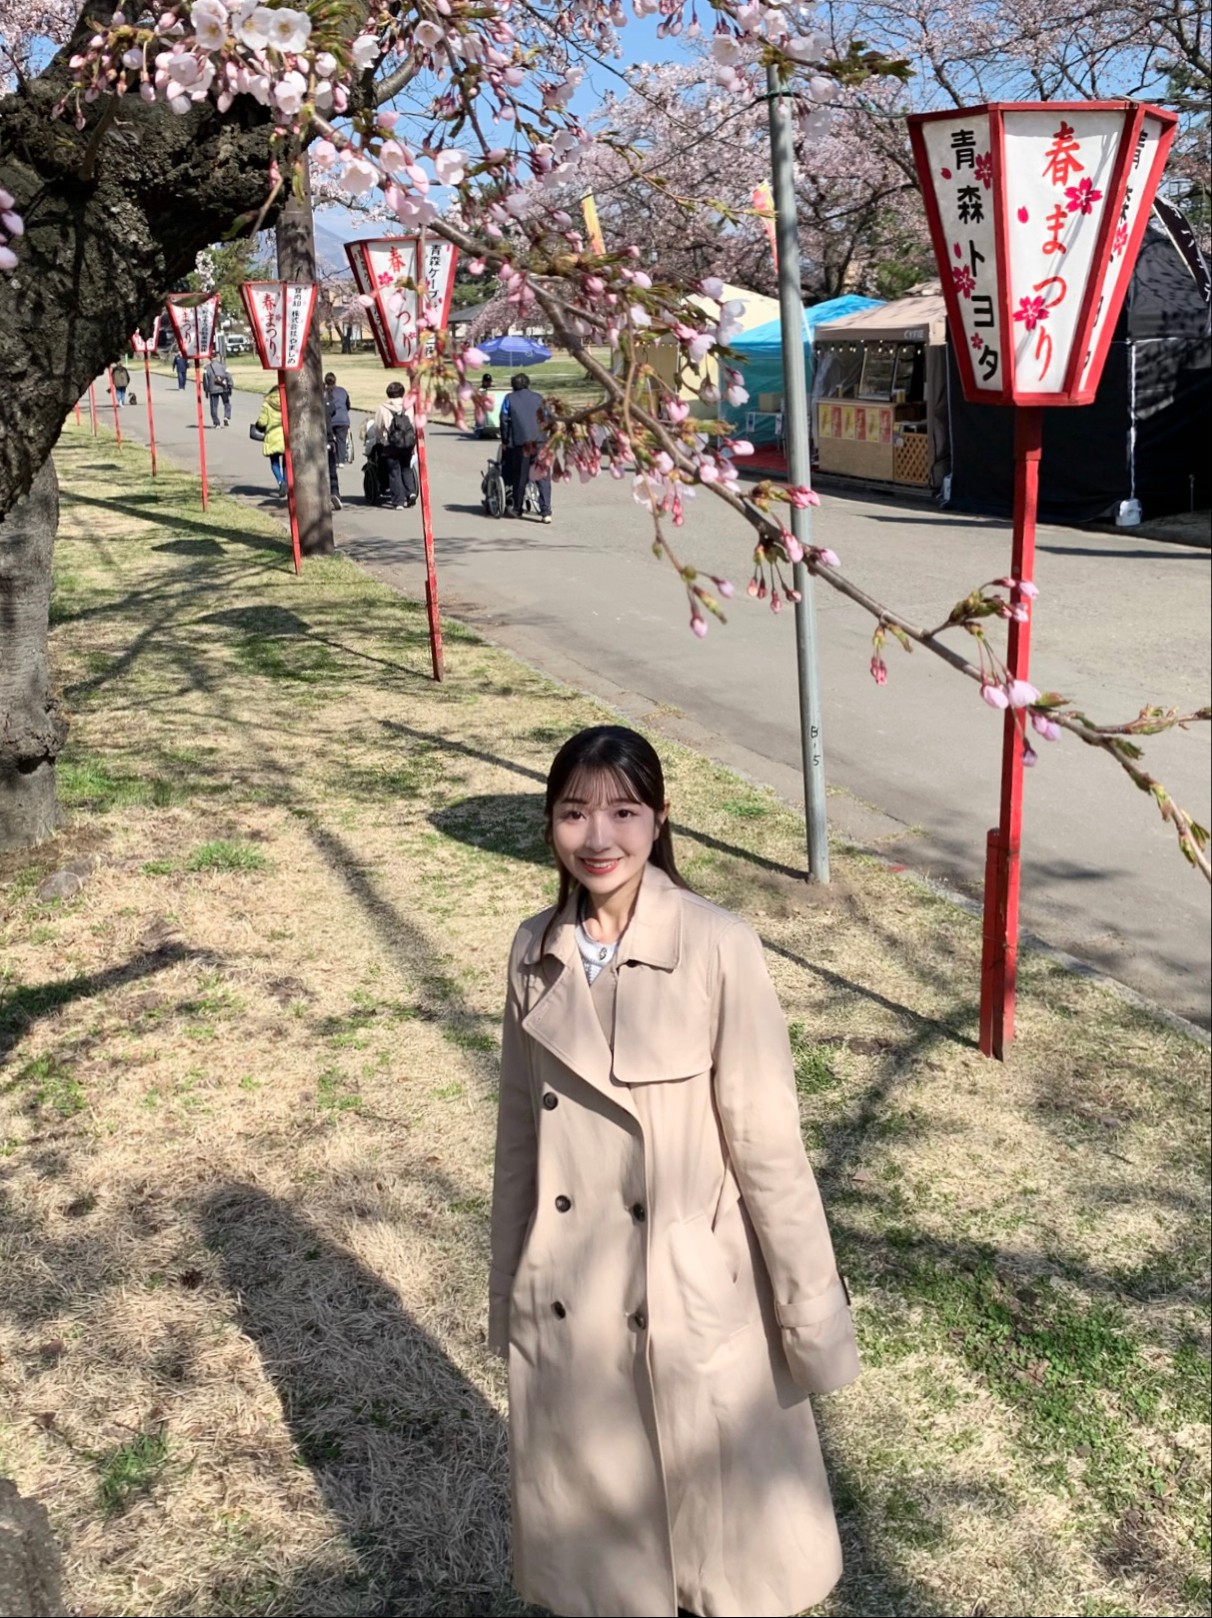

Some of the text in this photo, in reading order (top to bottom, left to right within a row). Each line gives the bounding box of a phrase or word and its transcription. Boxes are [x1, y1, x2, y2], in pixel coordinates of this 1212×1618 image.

[388, 246, 412, 358] 春つり
[951, 129, 998, 381] 青森トヨタ
[1033, 121, 1084, 382] 春まつり
[180, 307, 193, 344] まつり
[262, 292, 278, 357] 春まつり
